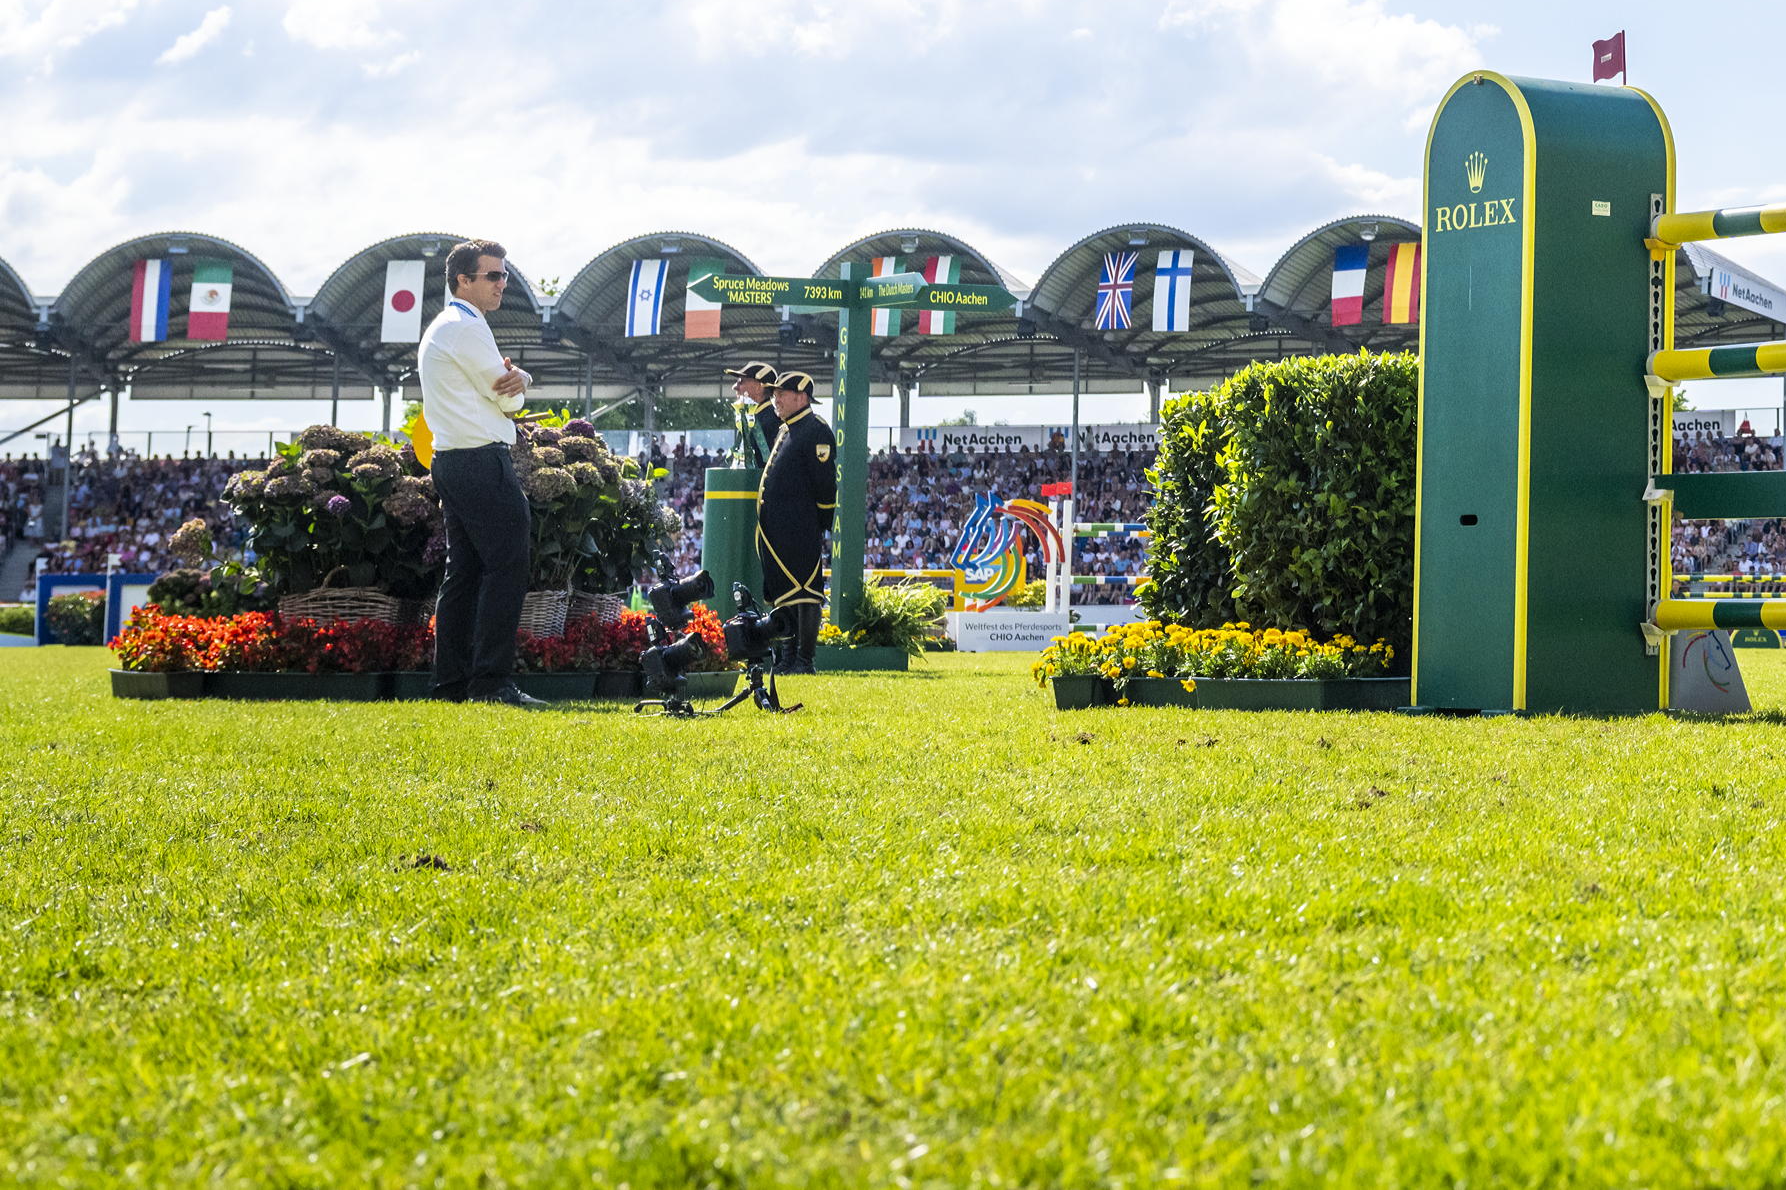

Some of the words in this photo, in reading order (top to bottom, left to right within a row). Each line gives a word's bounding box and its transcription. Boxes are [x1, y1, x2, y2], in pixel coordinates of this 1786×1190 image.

[1435, 198, 1516, 232] ROLEX
[713, 276, 744, 291] Spruce
[746, 278, 790, 291] Meadows
[804, 286, 827, 299] 7393
[828, 287, 842, 299] km
[929, 290, 955, 304] CHIO
[956, 293, 988, 305] Aachen
[1732, 283, 1773, 309] NetAachen
[837, 326, 848, 447] GRAND
[1672, 418, 1720, 431] Aachen
[943, 433, 1022, 445] NetAachen
[1079, 431, 1155, 443] NtAachen
[832, 470, 842, 559] SLAM
[965, 568, 995, 581] SAP
[965, 622, 998, 630] Weltfest
[1000, 622, 1013, 630] des
[1014, 622, 1062, 632] Pferdesports
[989, 633, 1012, 641] CHIO
[1014, 633, 1044, 641] Aachen
